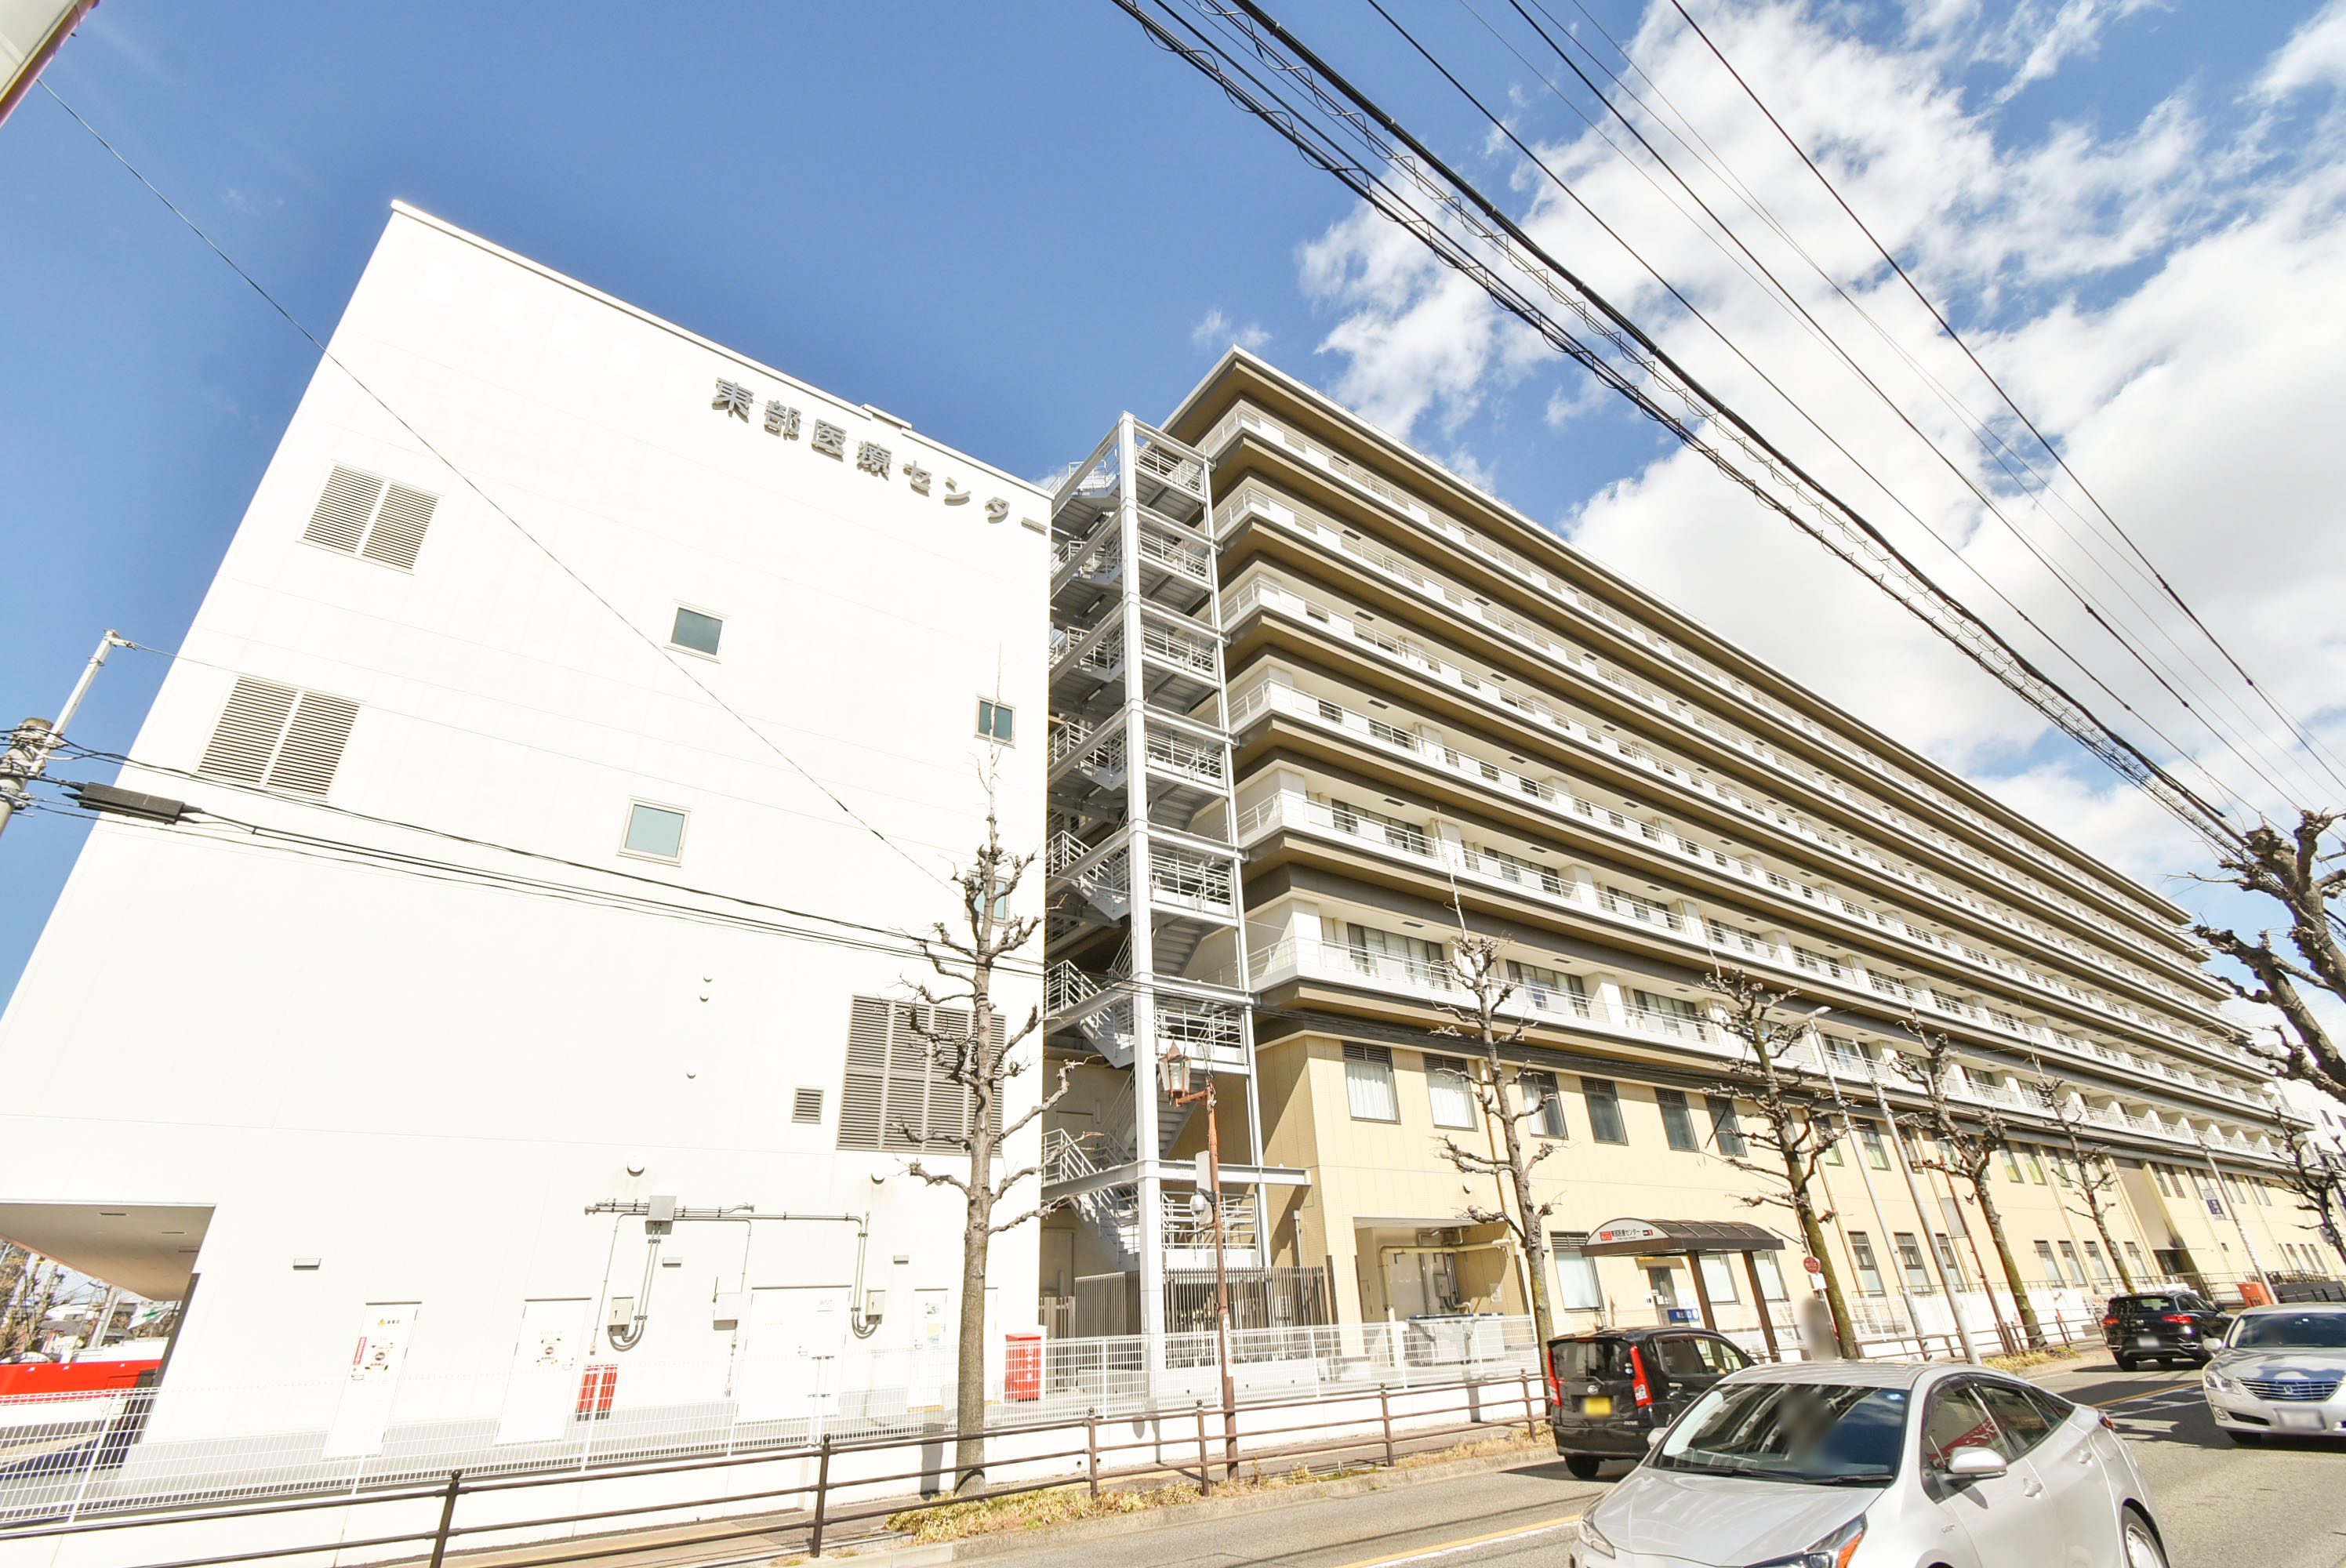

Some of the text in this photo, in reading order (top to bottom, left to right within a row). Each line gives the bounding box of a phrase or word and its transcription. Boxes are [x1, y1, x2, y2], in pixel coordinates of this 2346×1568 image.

[712, 378, 1047, 535] 東部医療センター
